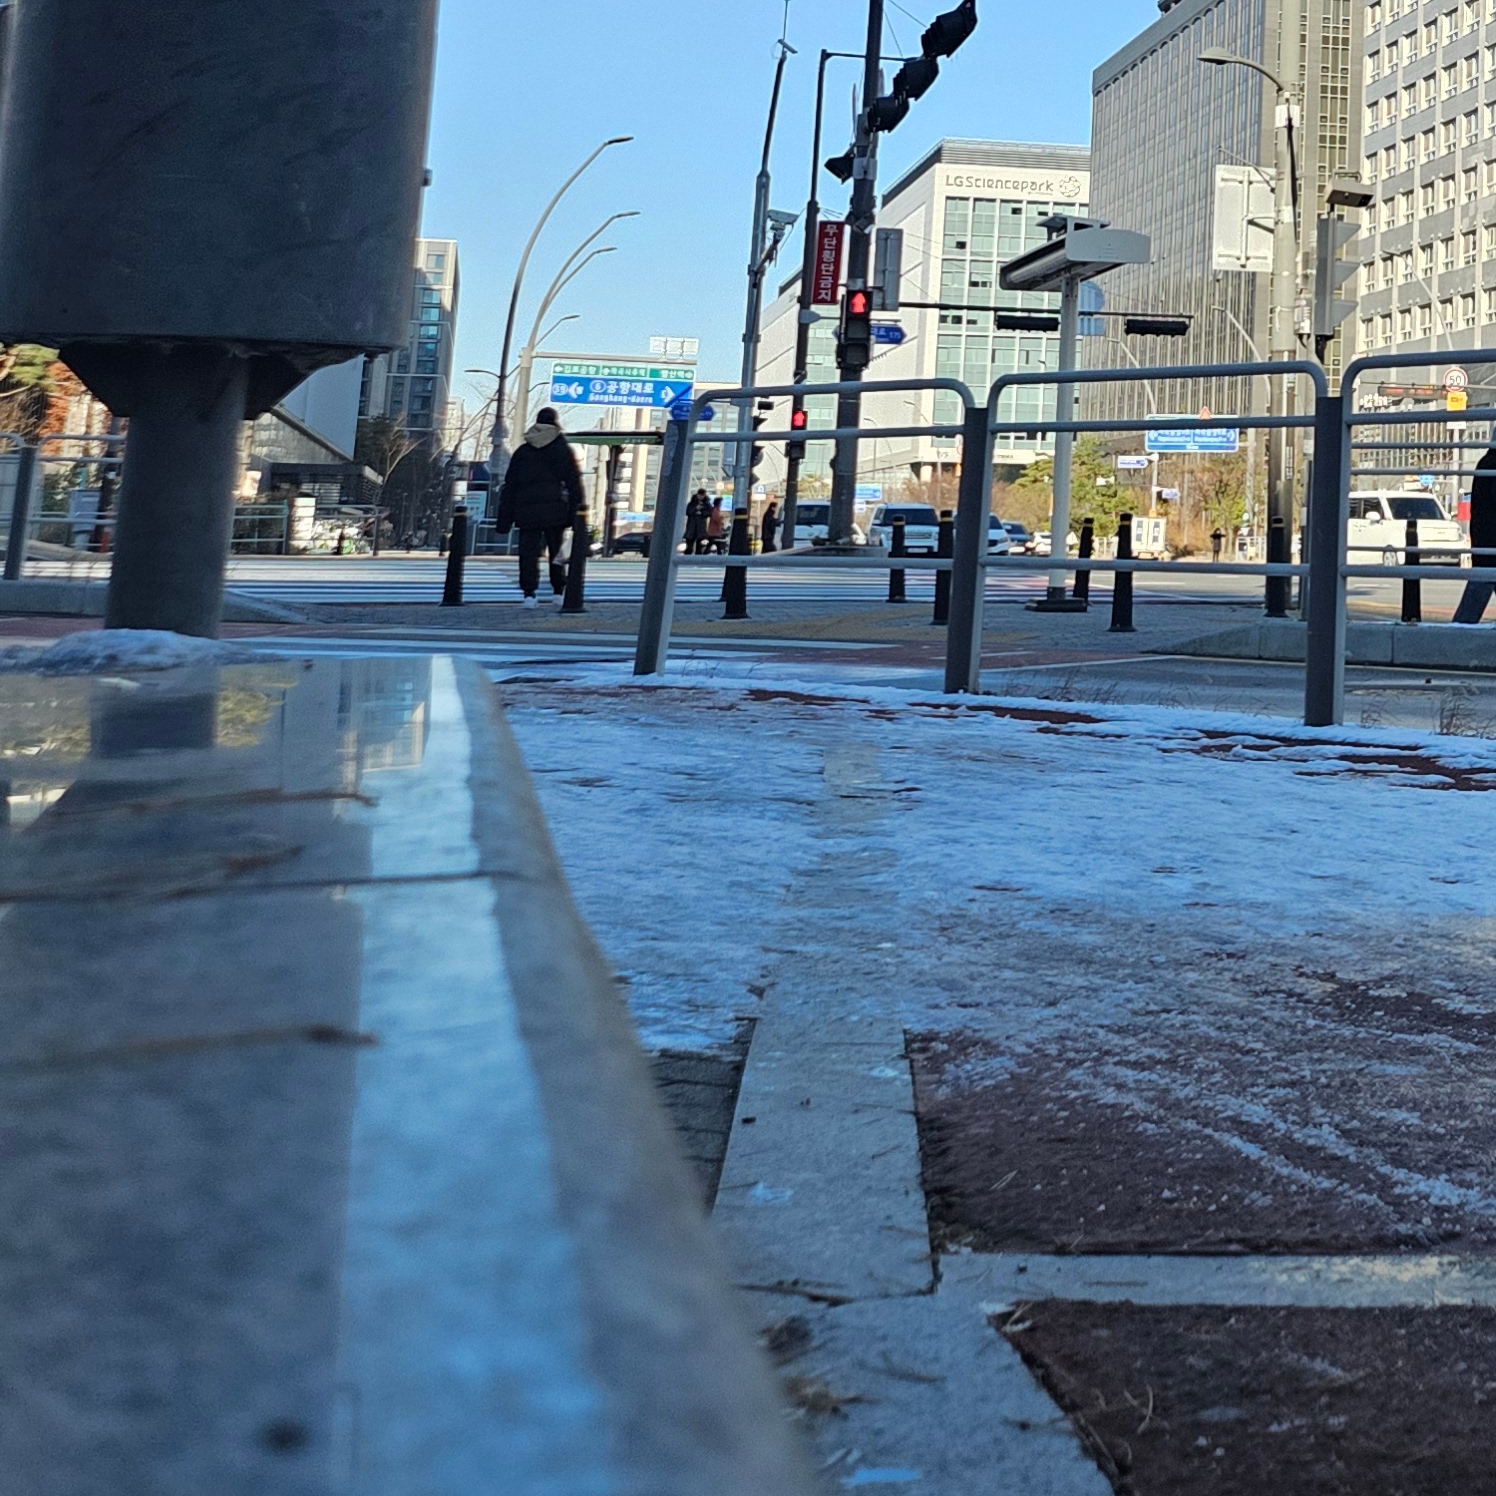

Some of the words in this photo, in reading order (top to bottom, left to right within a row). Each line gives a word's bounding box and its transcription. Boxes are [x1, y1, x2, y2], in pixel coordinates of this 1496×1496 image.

[818, 224, 839, 302] 무단횡단금지
[1450, 375, 1461, 385] 50
[607, 381, 654, 394] 공항대로
